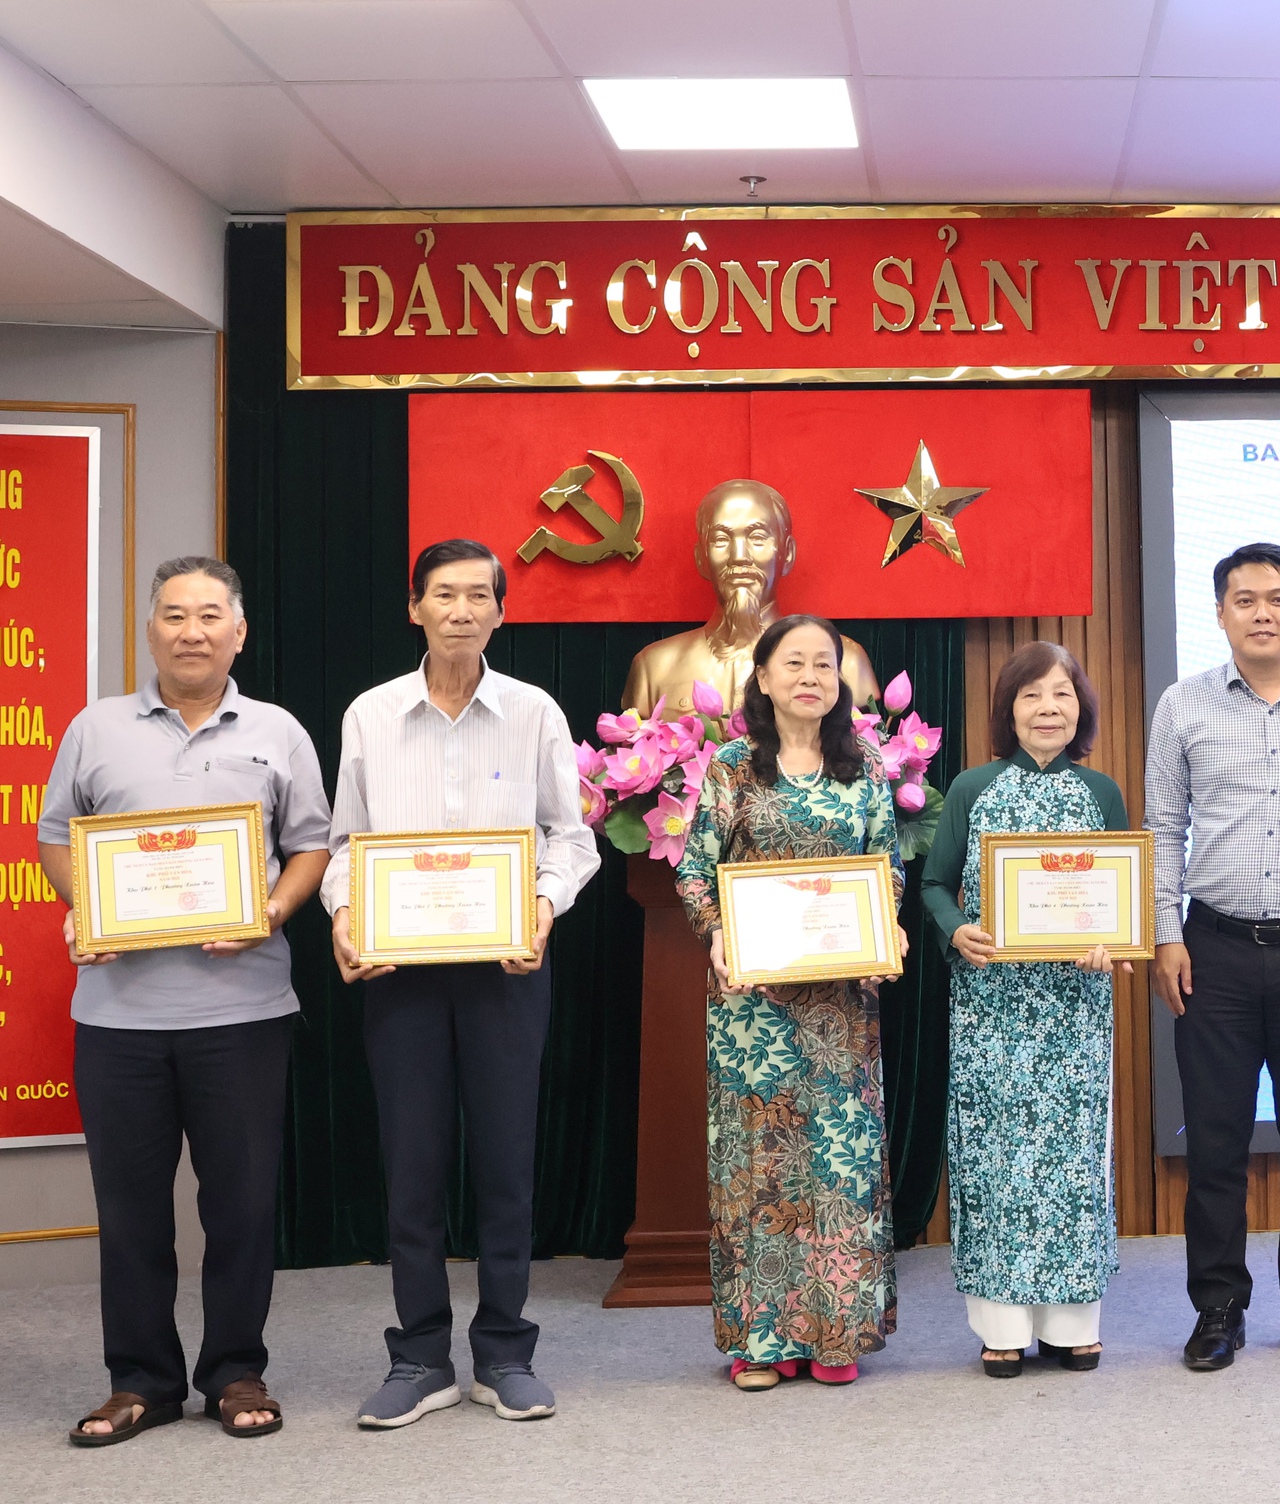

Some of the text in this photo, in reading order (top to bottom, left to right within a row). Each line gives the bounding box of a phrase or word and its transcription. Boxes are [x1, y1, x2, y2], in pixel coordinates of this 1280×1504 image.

[338, 228, 574, 336] ĐẢNG
[606, 231, 837, 358] CỘNG
[872, 224, 1038, 332] SẢN
[1075, 231, 1278, 353] VIỆT
[0, 619, 45, 672] ÚC;
